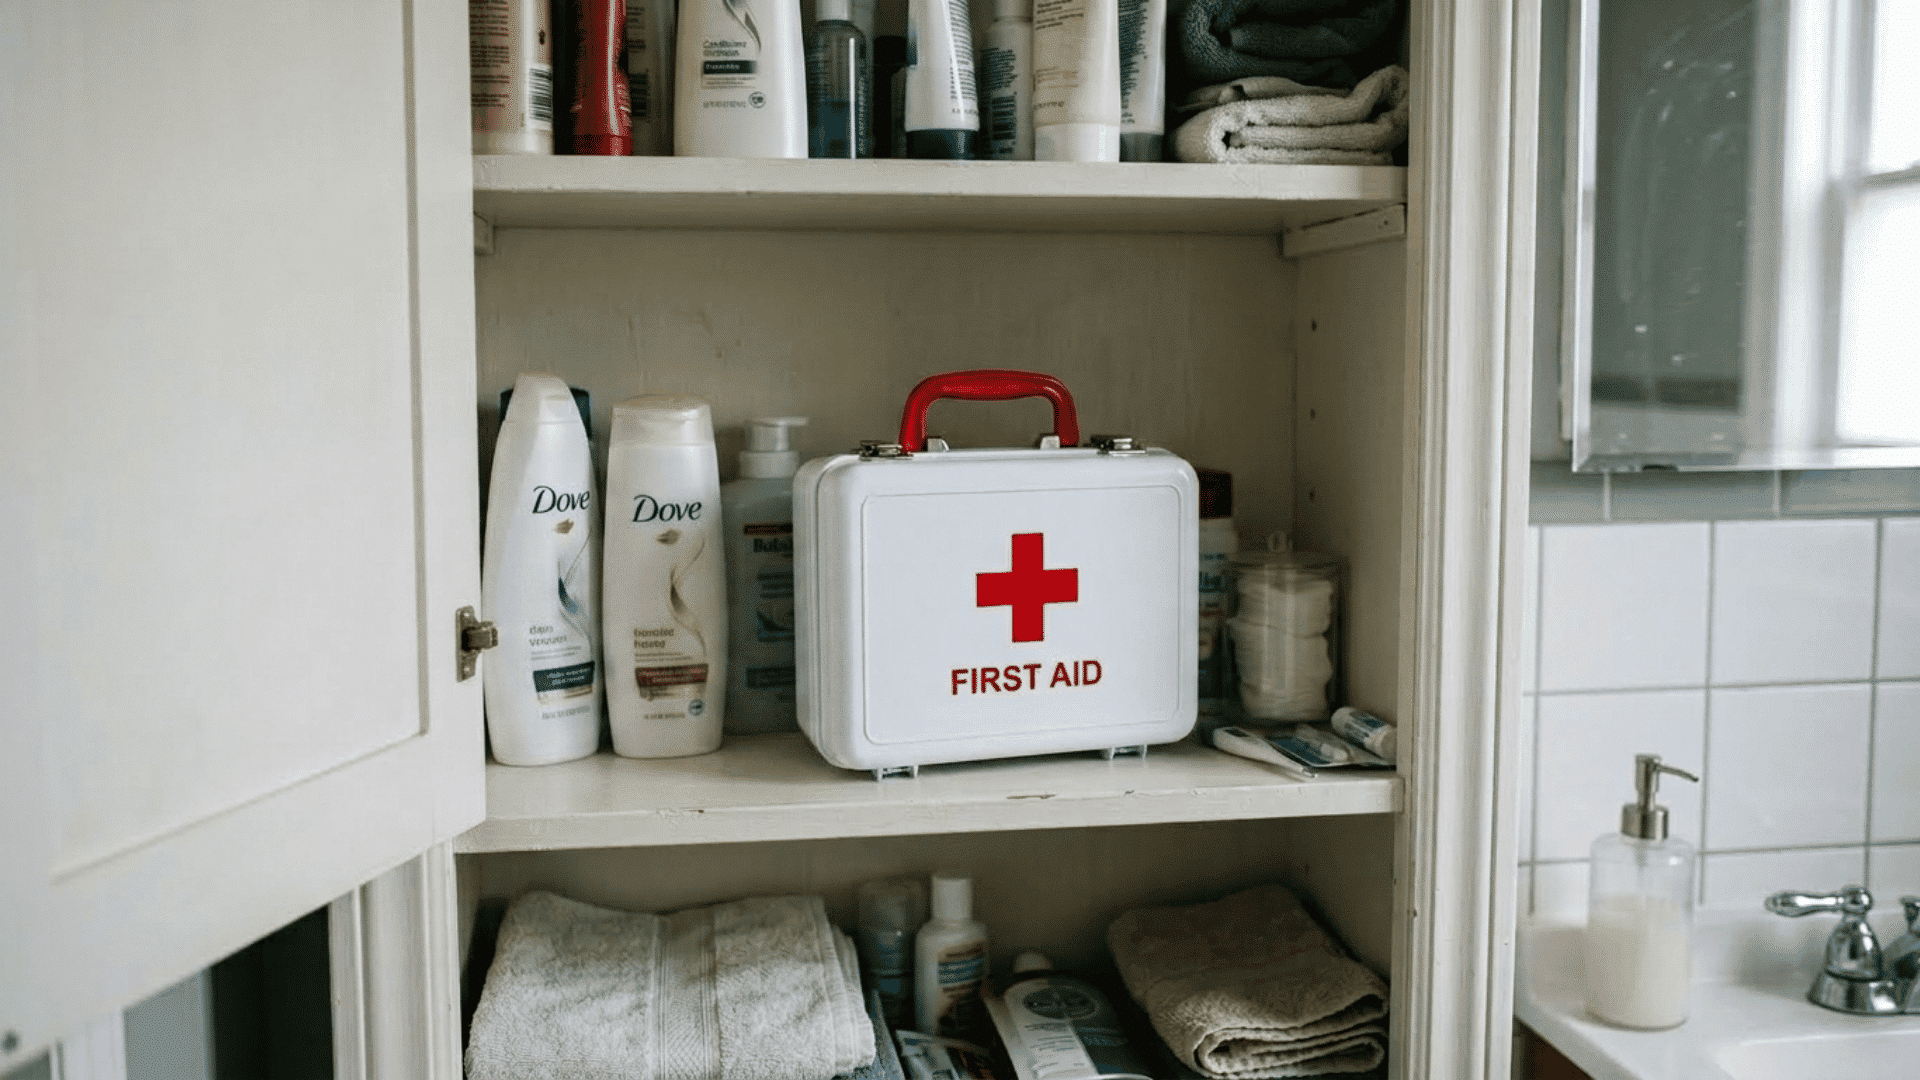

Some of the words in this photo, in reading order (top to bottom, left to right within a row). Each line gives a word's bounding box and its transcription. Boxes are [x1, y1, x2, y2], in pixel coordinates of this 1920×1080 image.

[532, 485, 590, 514] Dove
[632, 494, 702, 522] Dove
[952, 663, 1042, 695] FIRST
[1050, 660, 1102, 688] AID
